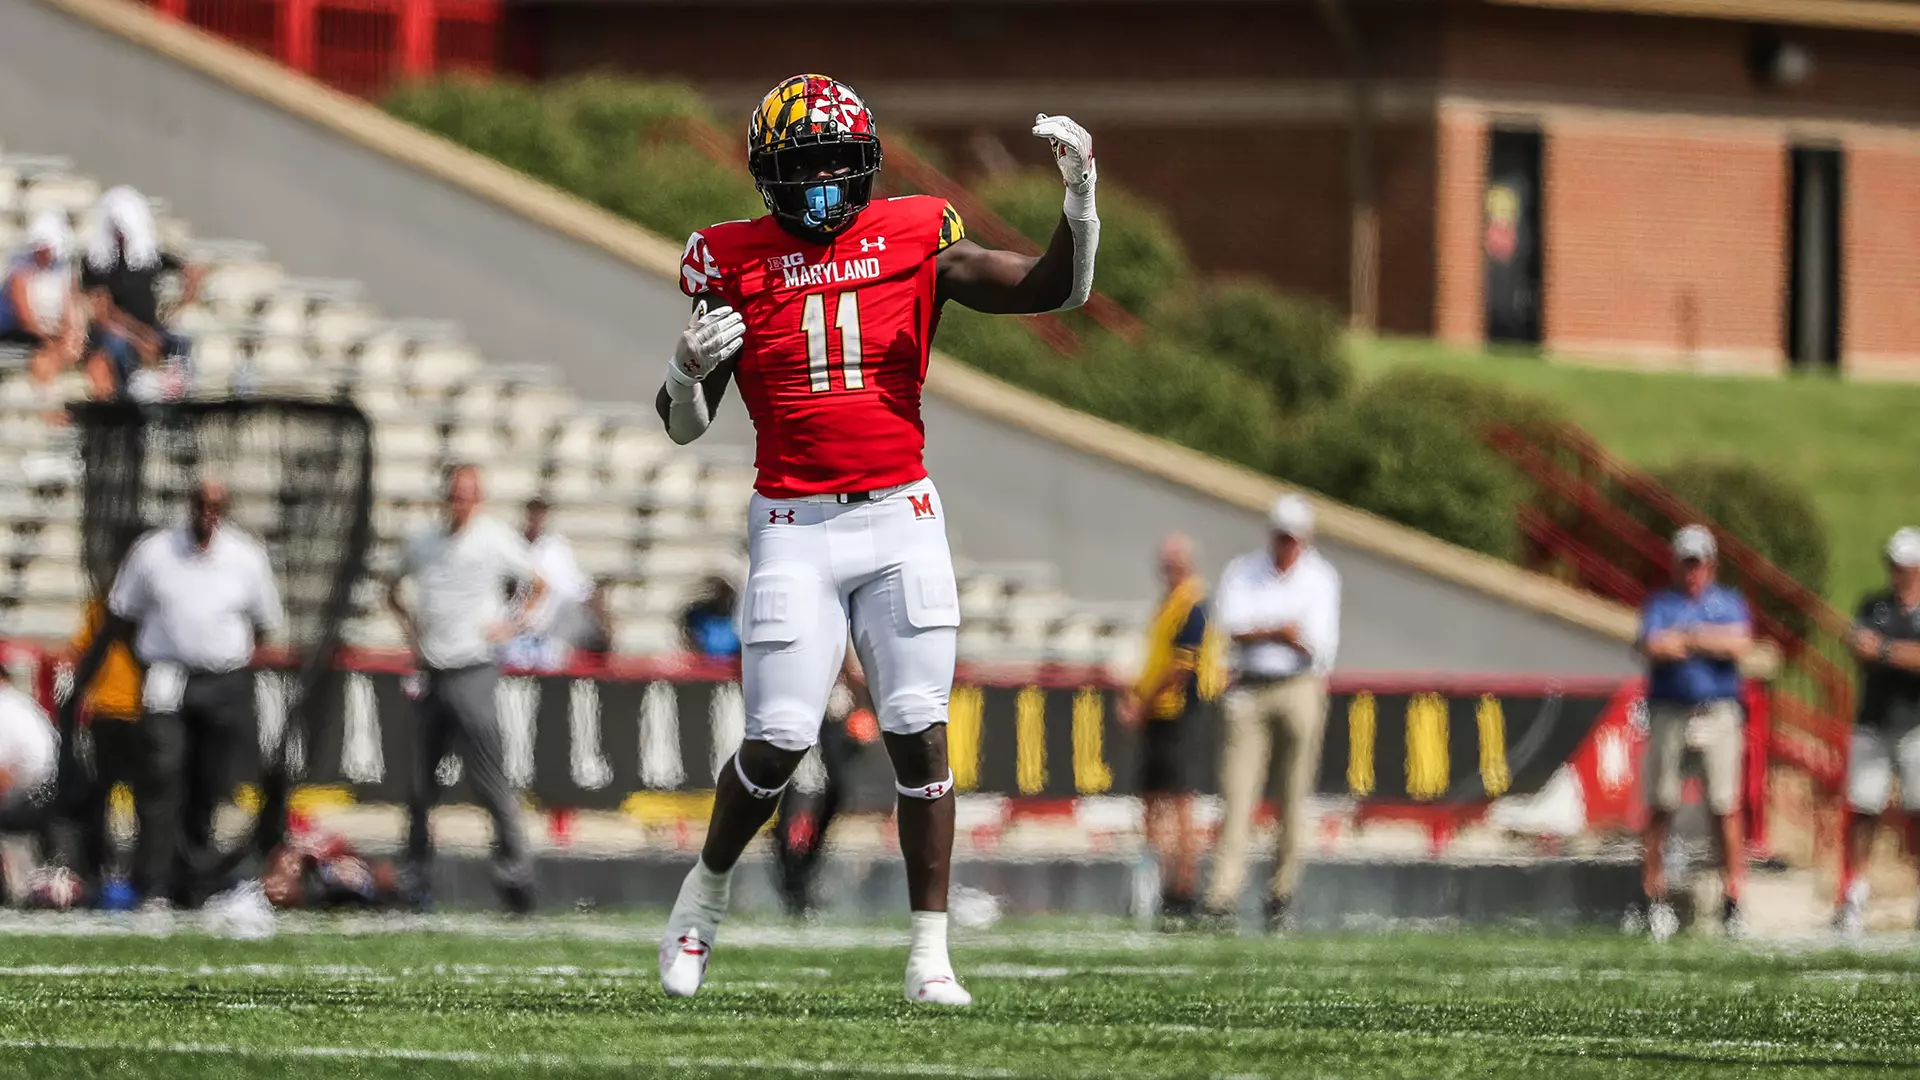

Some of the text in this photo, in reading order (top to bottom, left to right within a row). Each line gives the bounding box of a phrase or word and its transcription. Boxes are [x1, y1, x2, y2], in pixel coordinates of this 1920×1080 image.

[783, 257, 881, 288] MARYLAND
[801, 290, 865, 394] 11
[906, 493, 935, 517] M
